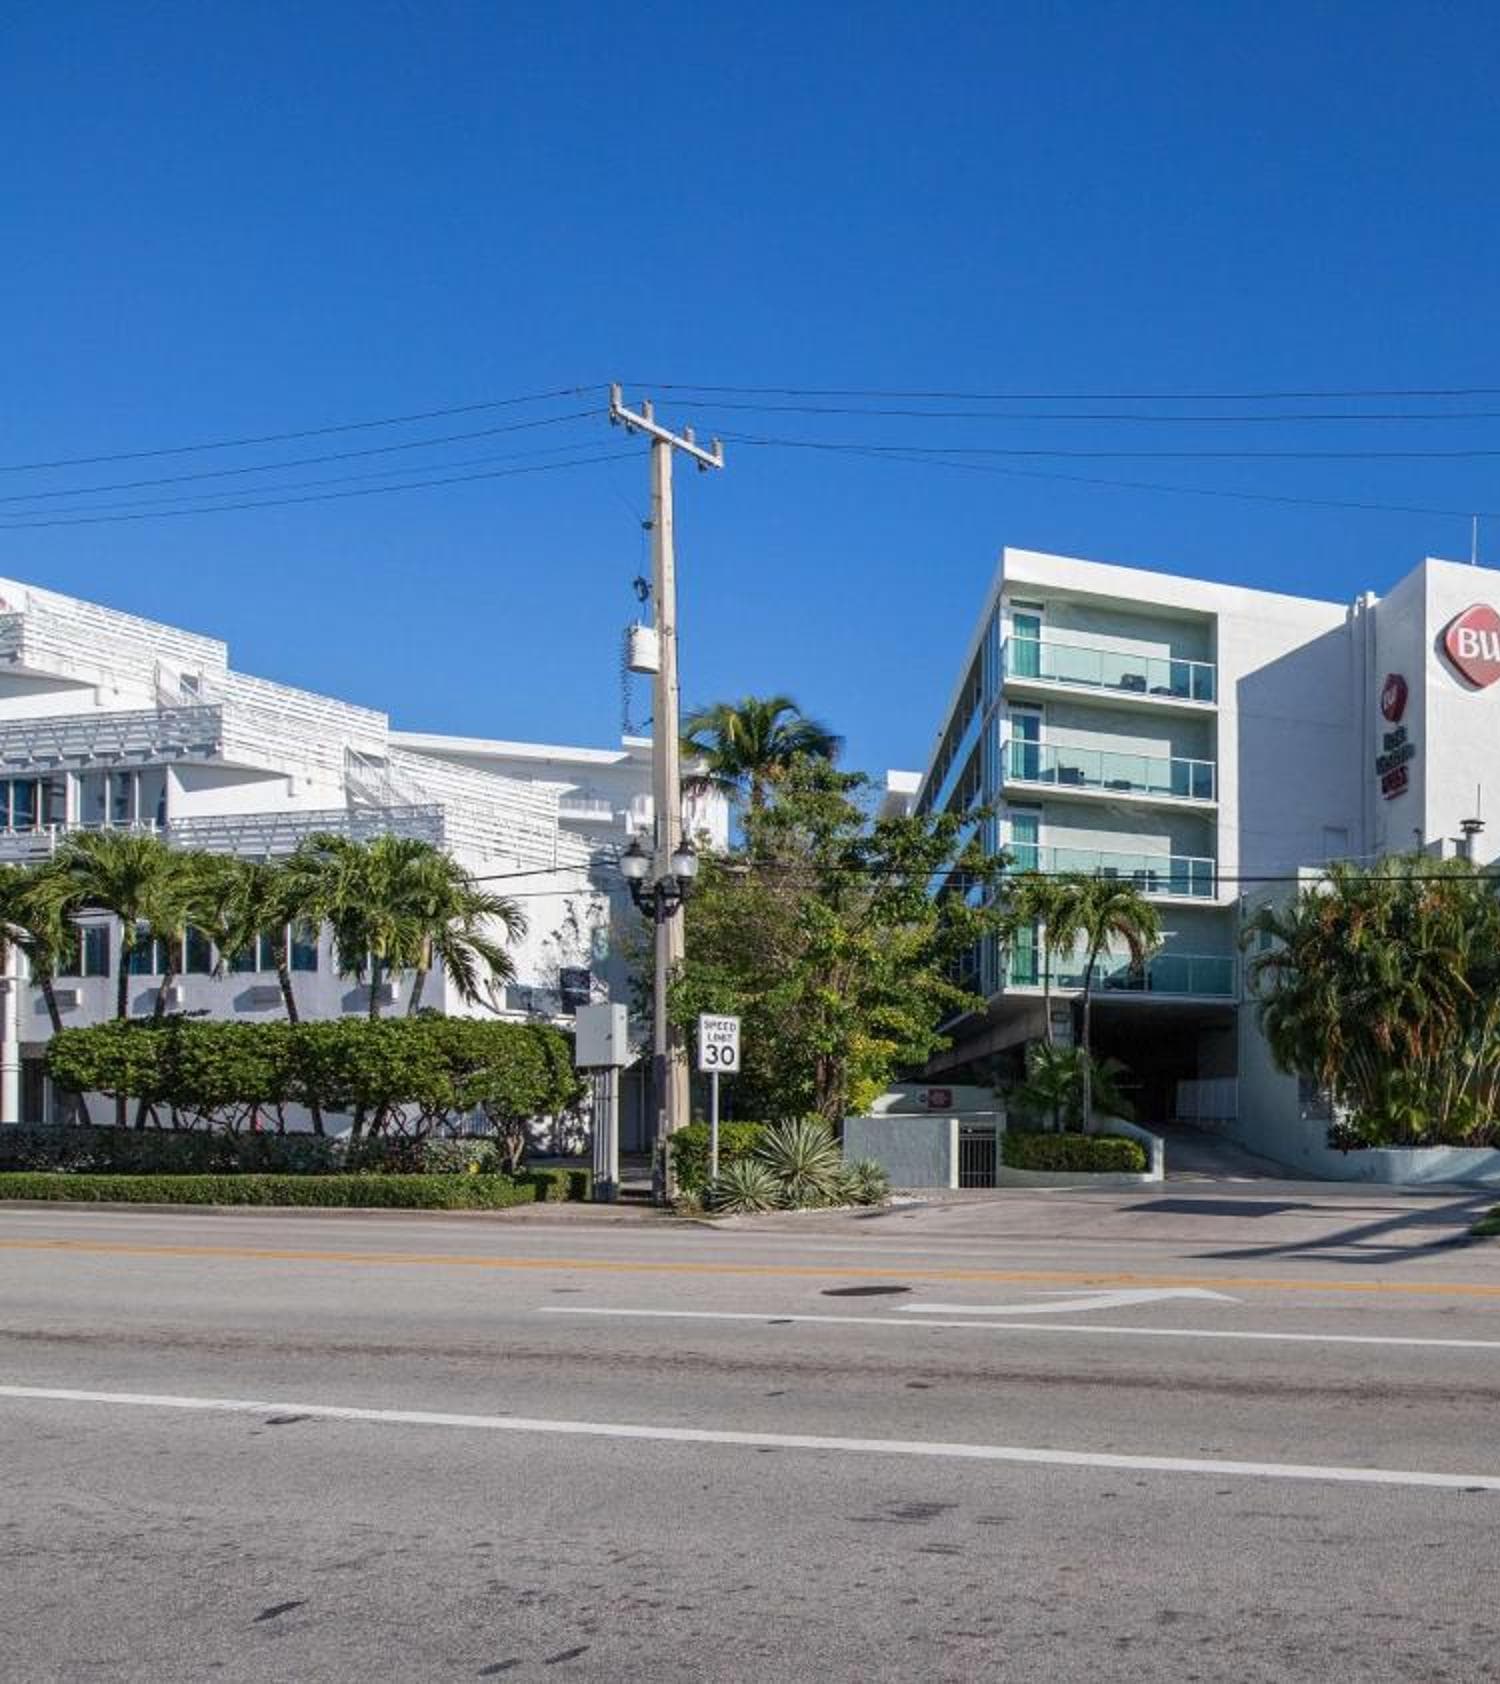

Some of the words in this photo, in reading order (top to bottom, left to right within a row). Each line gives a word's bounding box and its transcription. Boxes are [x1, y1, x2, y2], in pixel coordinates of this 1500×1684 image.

[704, 1021, 736, 1031] SPEED
[708, 1032, 733, 1041] LIMIT
[706, 1044, 734, 1065] 30
